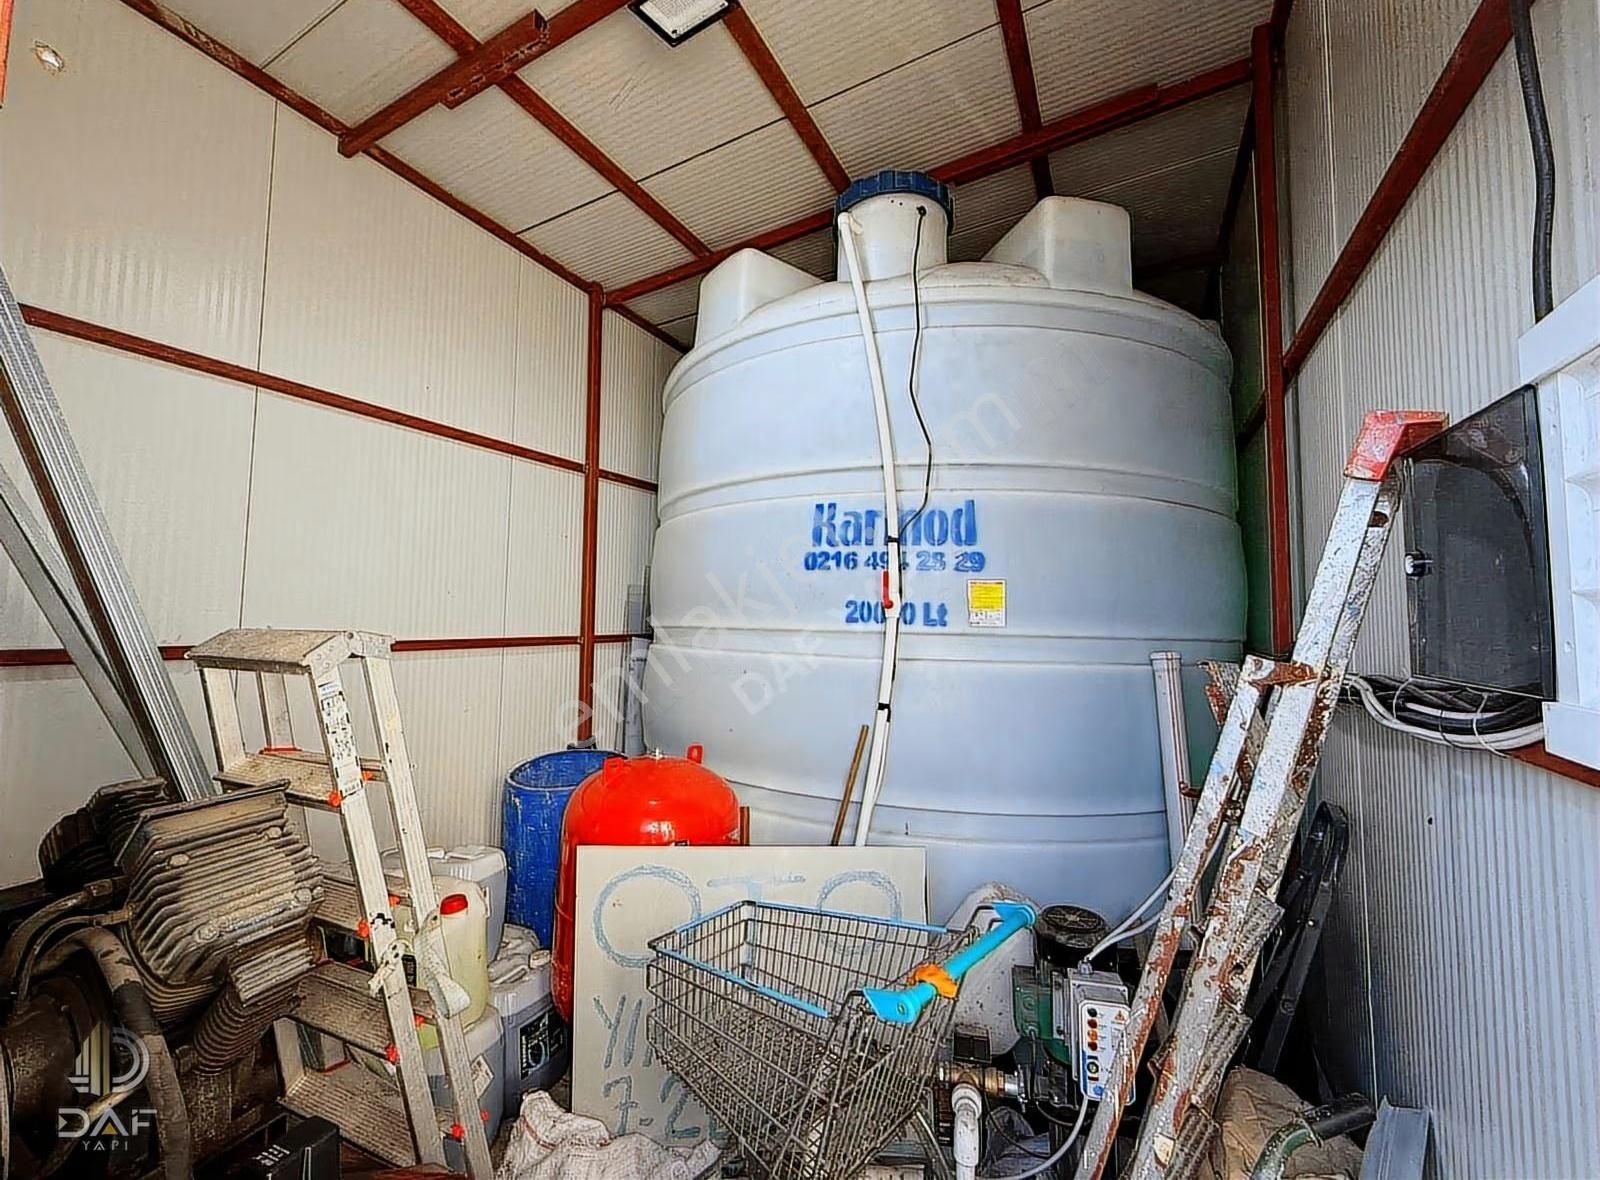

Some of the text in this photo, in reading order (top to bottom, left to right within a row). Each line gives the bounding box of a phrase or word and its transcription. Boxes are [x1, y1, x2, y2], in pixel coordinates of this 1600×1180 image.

[804, 551, 858, 570] 0216
[953, 552, 986, 572] 29
[845, 600, 916, 625] 2000
[923, 601, 948, 627] Lt
